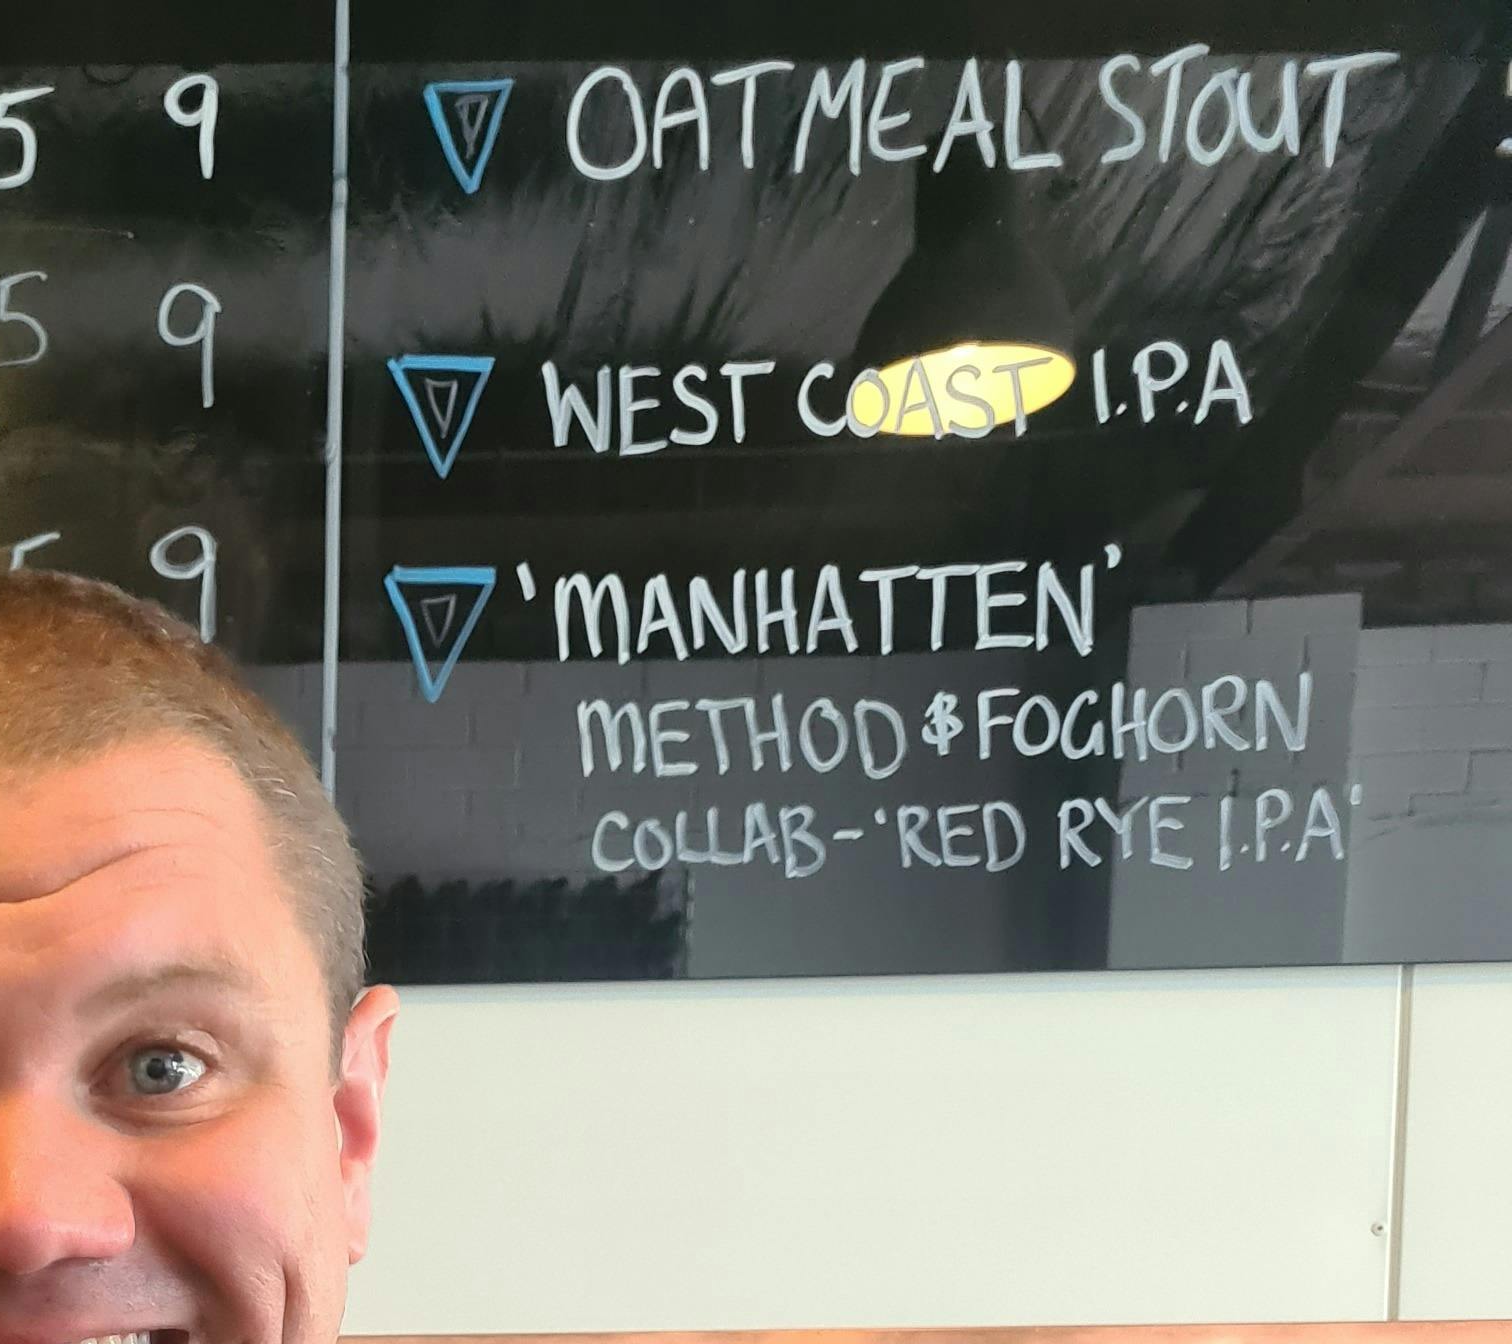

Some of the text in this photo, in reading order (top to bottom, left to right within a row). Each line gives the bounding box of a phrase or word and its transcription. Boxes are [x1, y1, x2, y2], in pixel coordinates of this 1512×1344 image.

[163, 73, 220, 180] 9
[565, 56, 1064, 181] OATMEAL
[1098, 42, 1402, 169] STOUT
[157, 282, 223, 409] 9
[541, 338, 1256, 456] WEST COAST I.P.A
[149, 524, 218, 645] 9
[576, 692, 908, 780] METHOD
[977, 671, 1314, 762] FOGHORN
[1056, 794, 1195, 871] RYE
